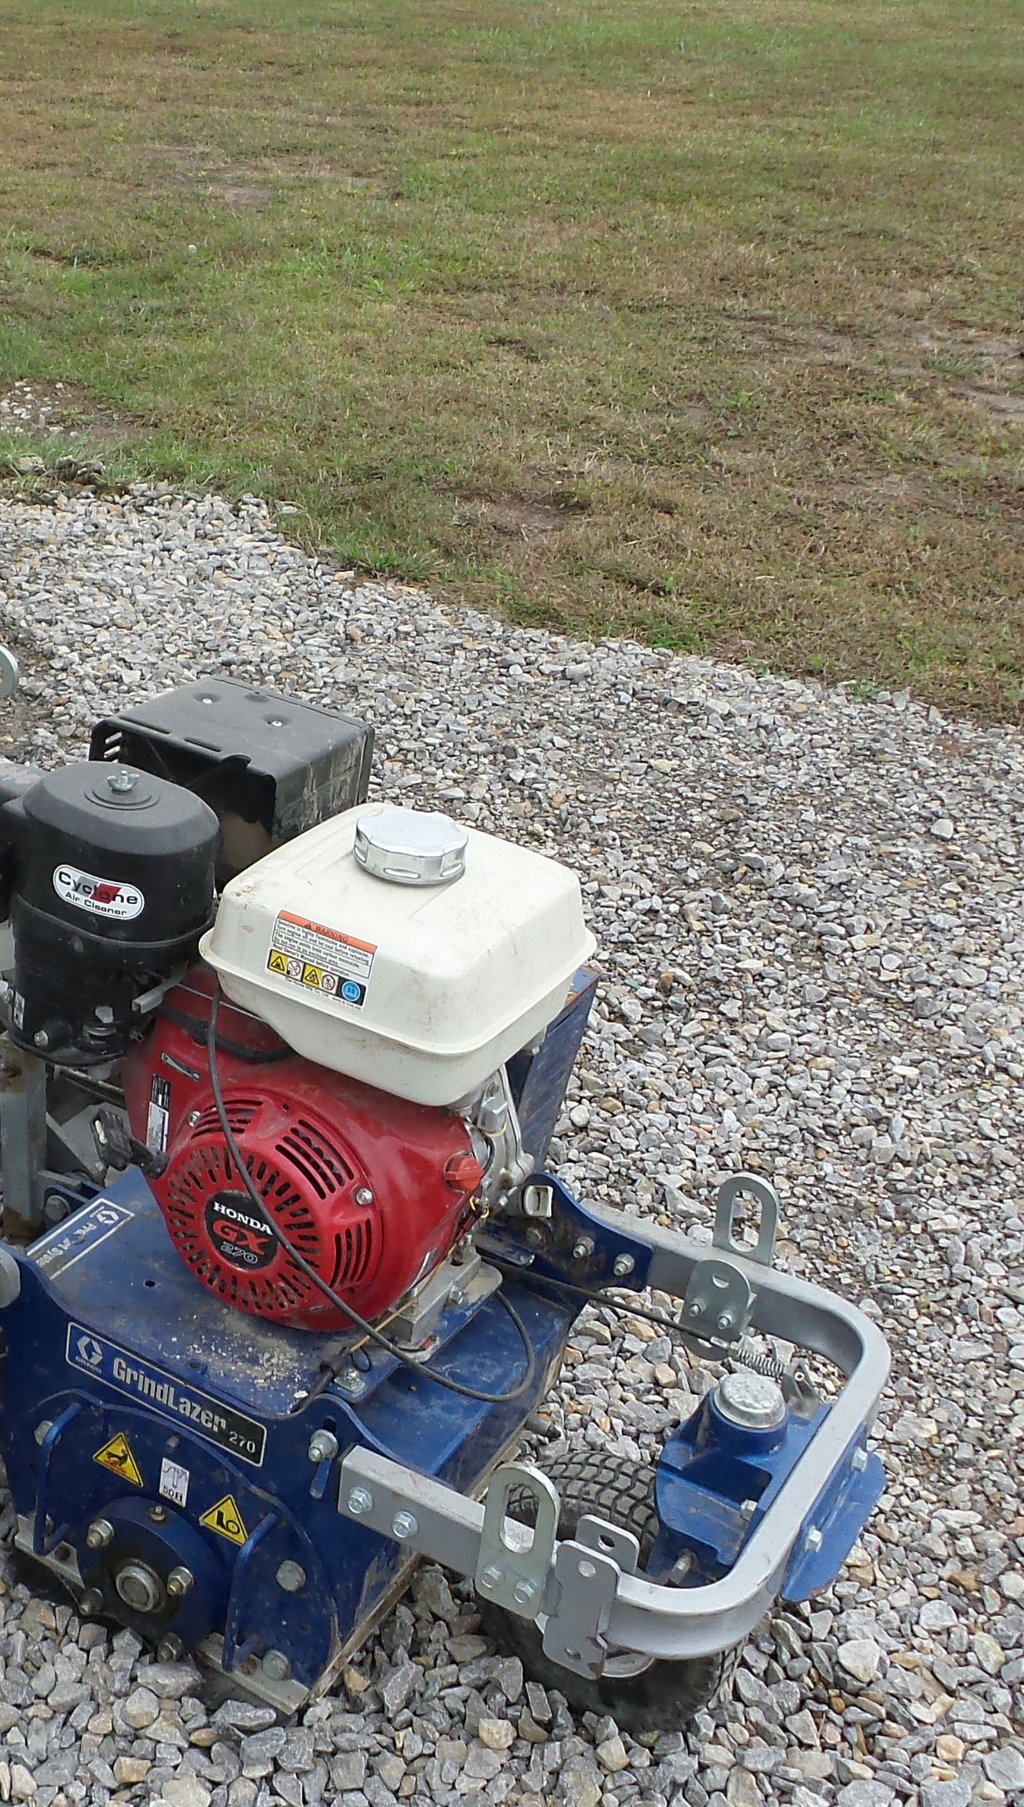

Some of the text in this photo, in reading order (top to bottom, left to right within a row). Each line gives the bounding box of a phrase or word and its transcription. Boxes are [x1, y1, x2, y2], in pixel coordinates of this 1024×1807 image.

[58, 871, 138, 905] Cyclone
[65, 891, 128, 916] Air Cleaner
[315, 924, 349, 943] WARNING
[213, 1201, 273, 1235] HONDA
[212, 1219, 269, 1256] GX
[220, 1241, 258, 1264] 270
[112, 1356, 256, 1454] GrindLazer 270
